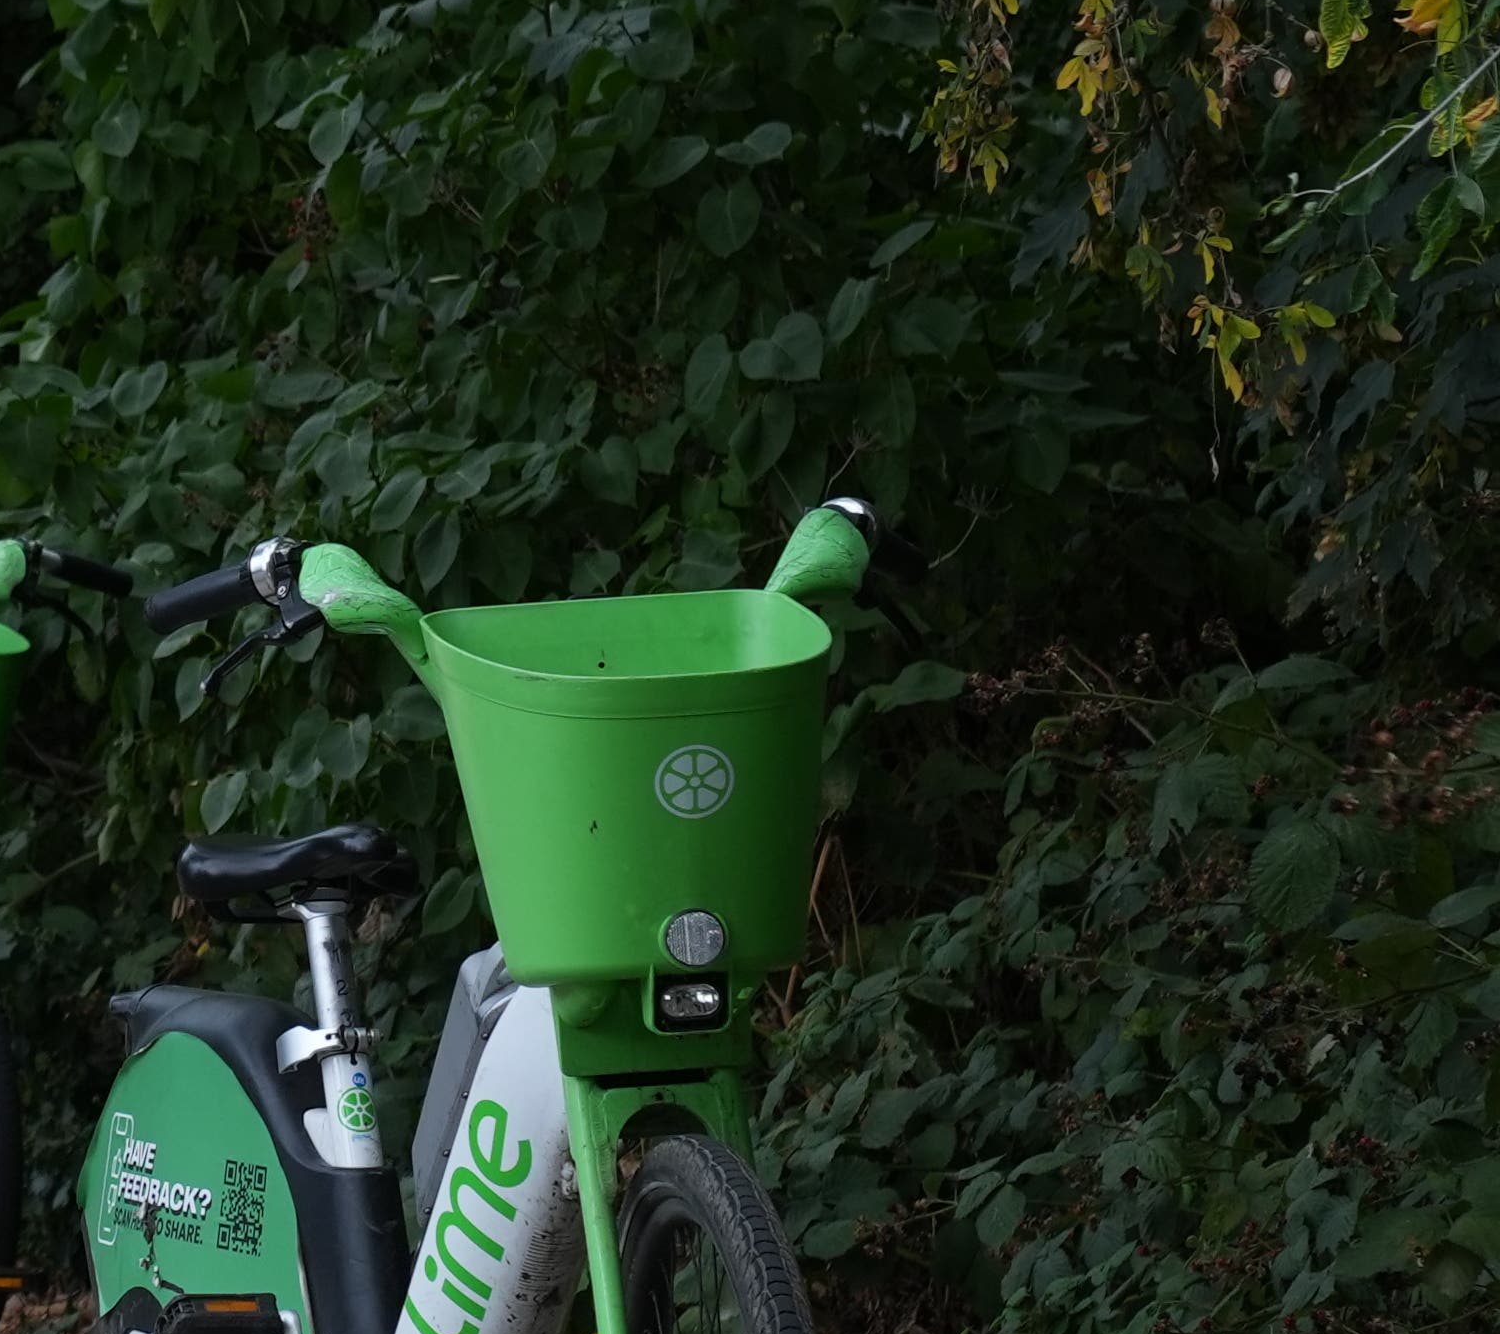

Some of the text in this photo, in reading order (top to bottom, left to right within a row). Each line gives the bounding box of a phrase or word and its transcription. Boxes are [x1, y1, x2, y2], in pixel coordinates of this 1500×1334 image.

[337, 979, 348, 996] 2
[123, 1138, 157, 1172] HAVE
[118, 1171, 212, 1219] FEEDBACK?
[113, 1208, 131, 1227] SCAN
[164, 1219, 203, 1245] SHARE.
